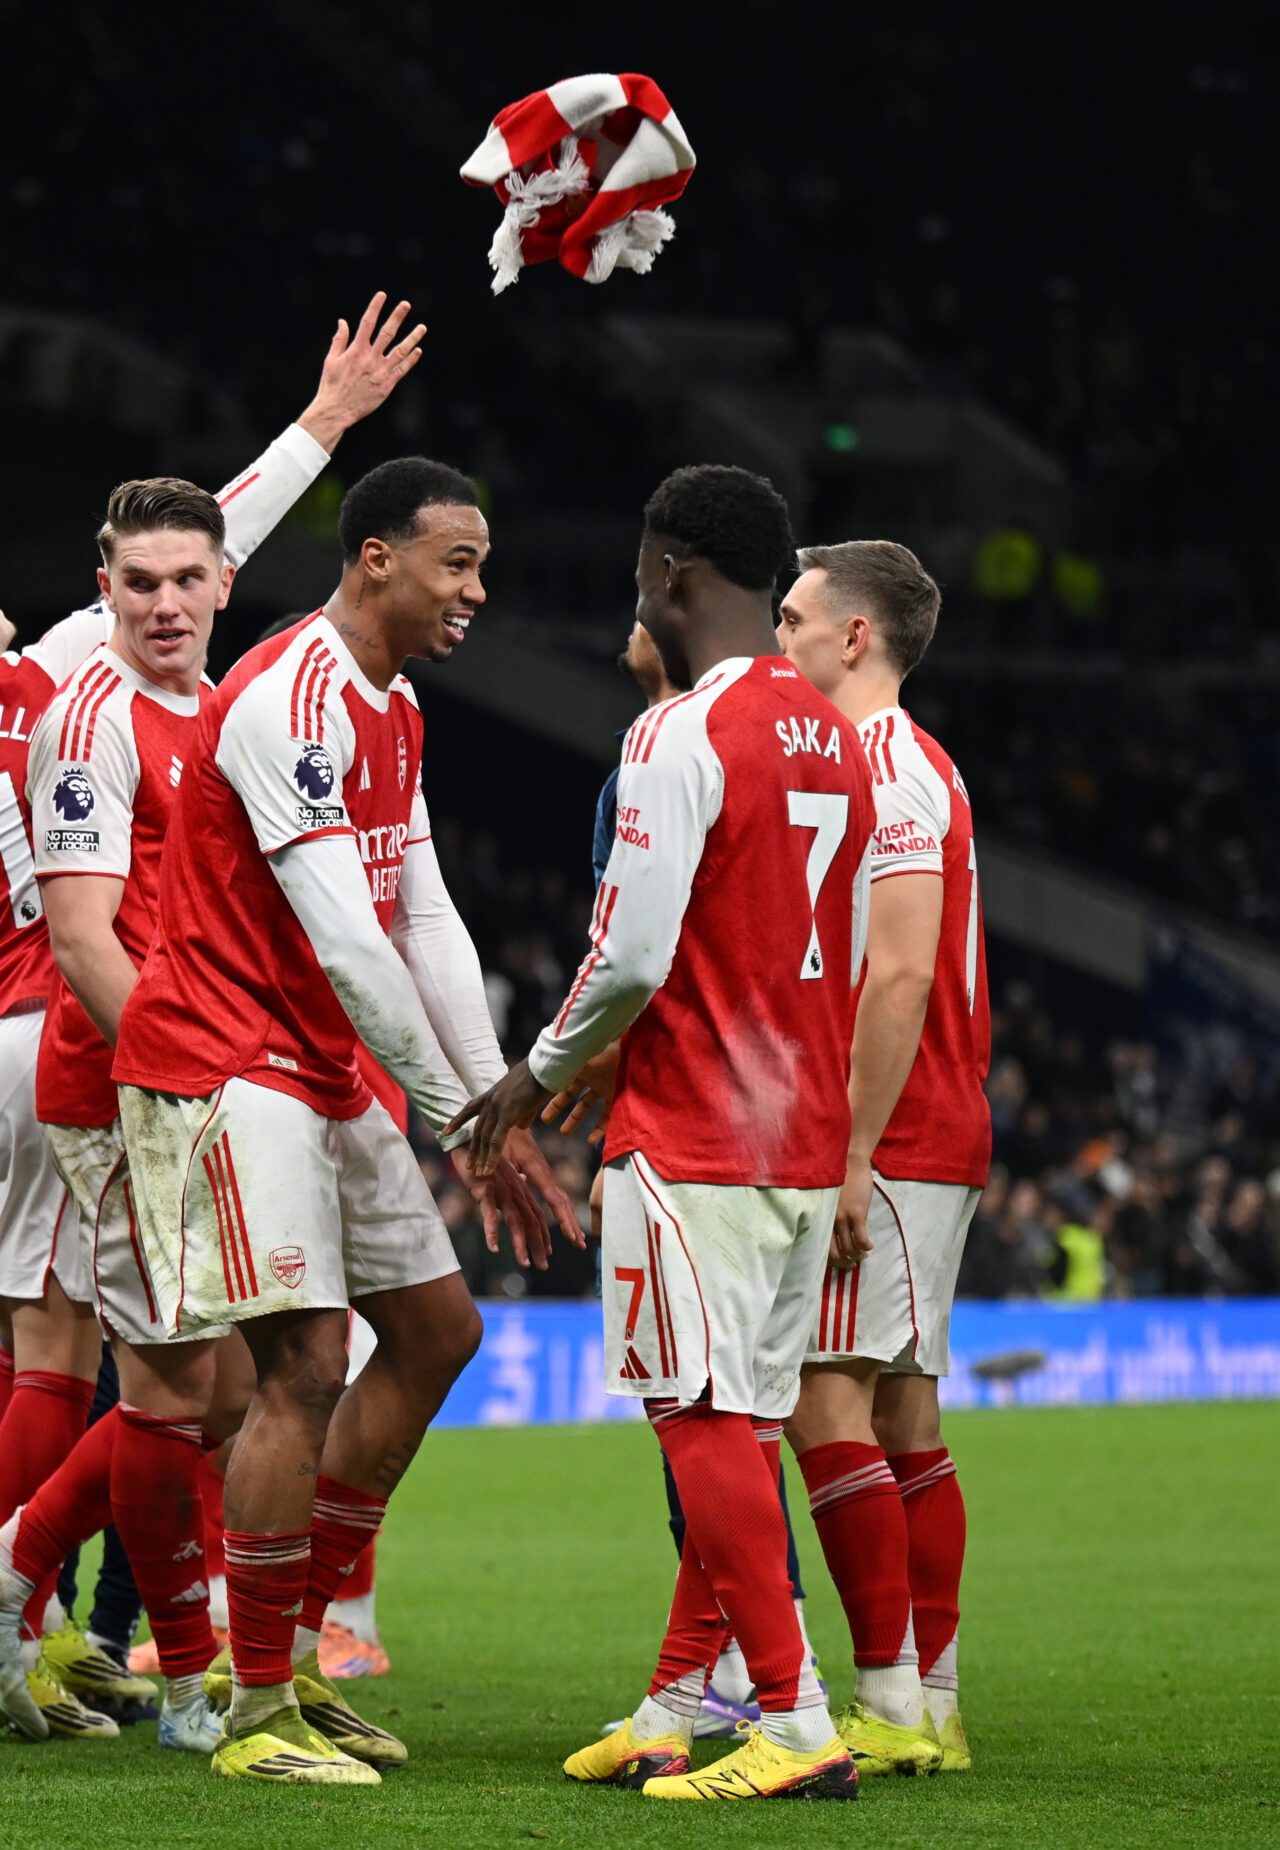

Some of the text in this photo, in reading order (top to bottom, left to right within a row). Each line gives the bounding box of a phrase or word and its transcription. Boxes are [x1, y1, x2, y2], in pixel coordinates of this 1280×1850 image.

[775, 716, 841, 765] SAKA
[296, 807, 314, 819] No
[46, 830, 94, 842] No room
[872, 820, 915, 845] VISIT
[62, 840, 99, 852] racism
[787, 790, 849, 981] 7
[274, 1252, 300, 1262] Arsenal
[614, 1266, 645, 1341] 7
